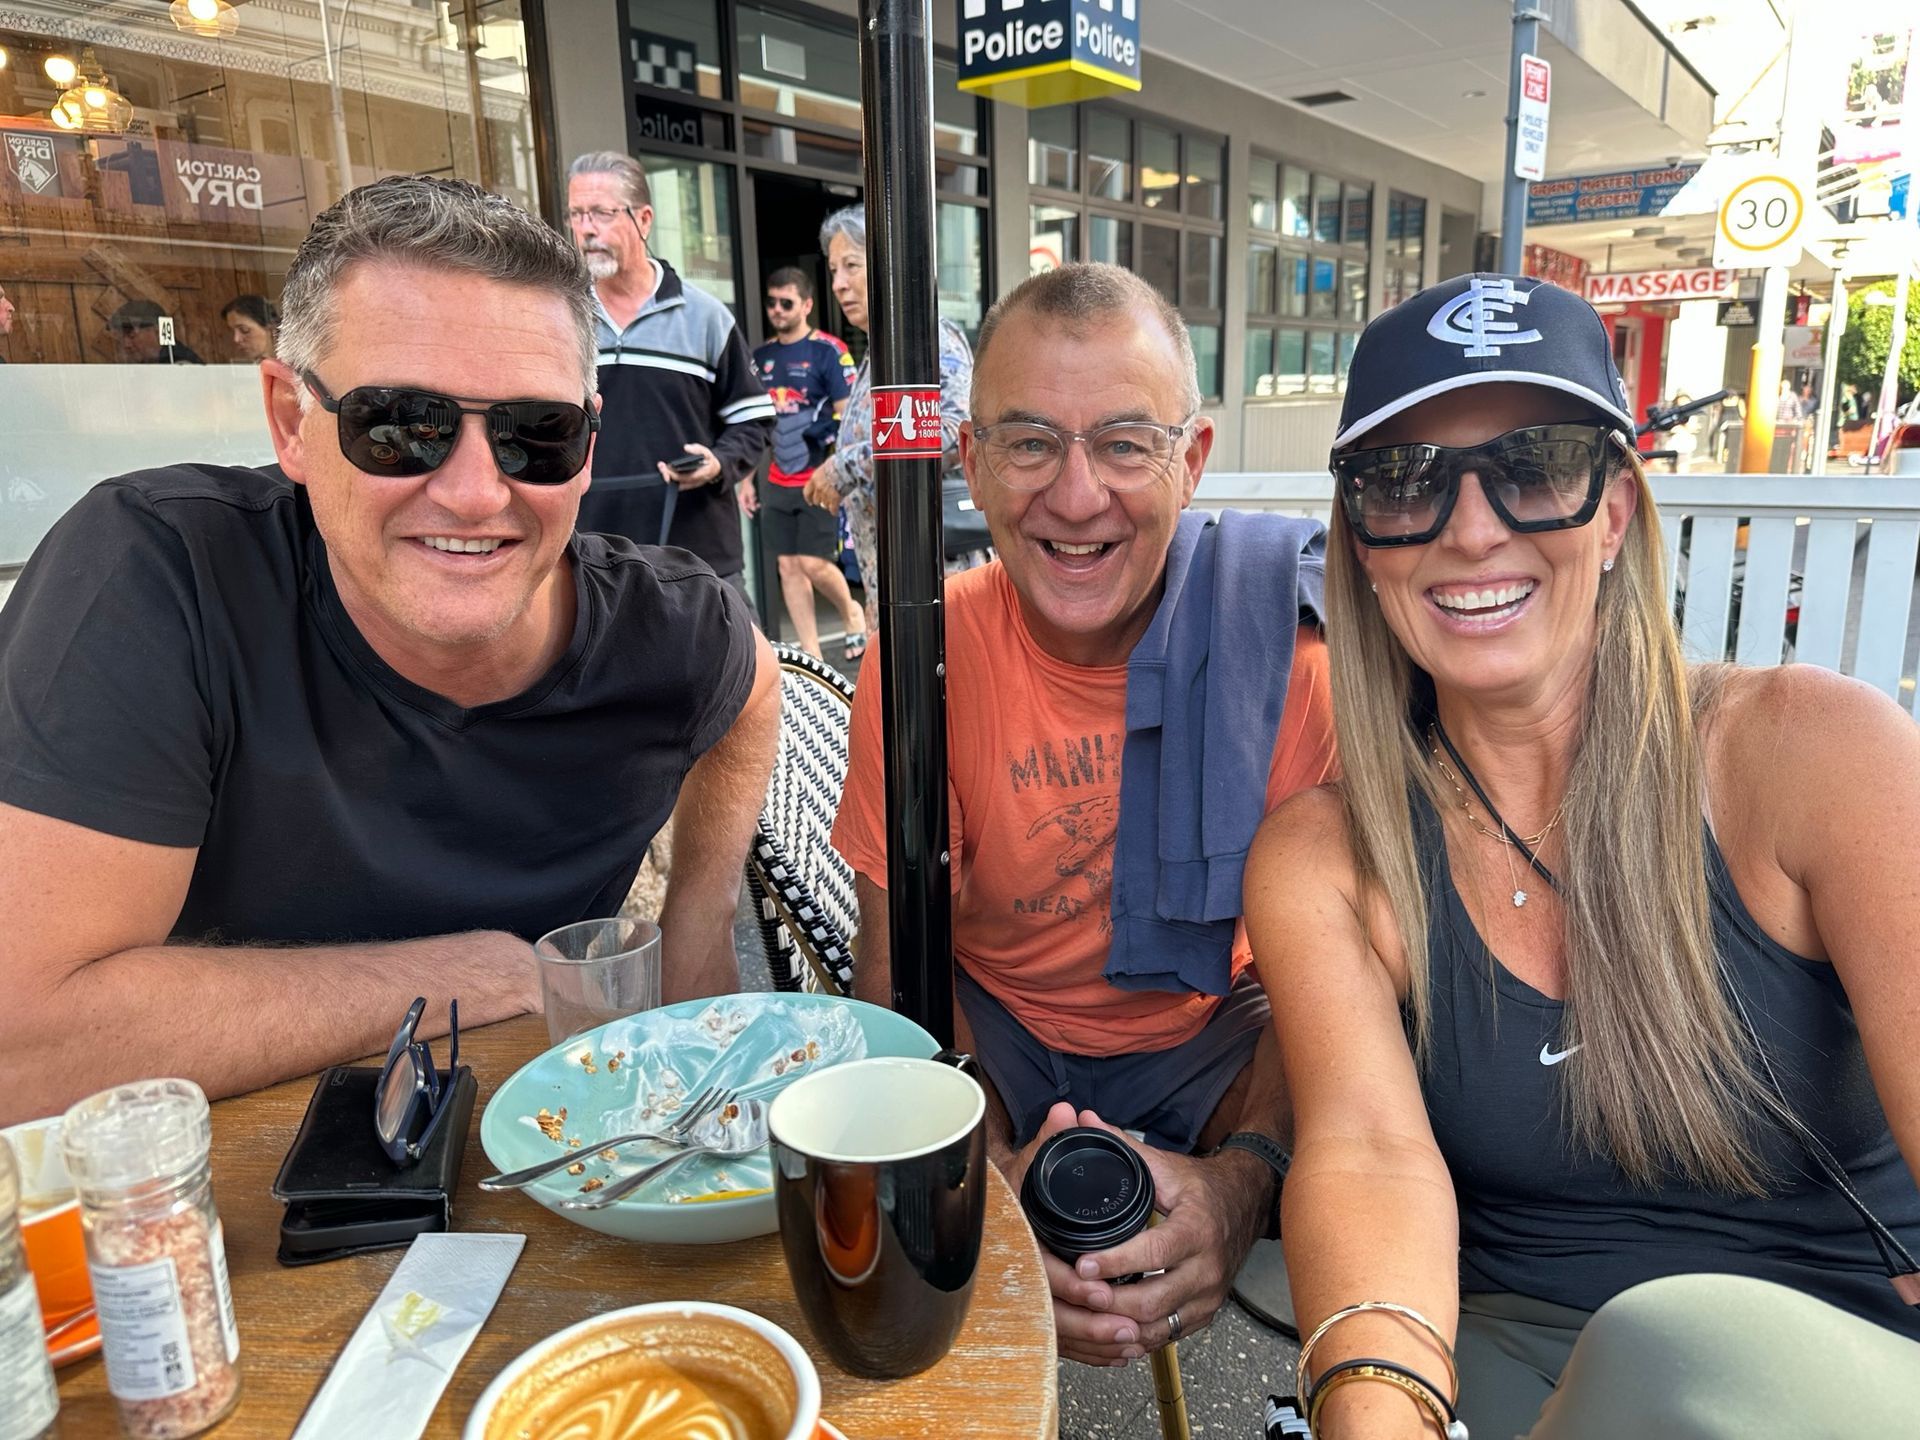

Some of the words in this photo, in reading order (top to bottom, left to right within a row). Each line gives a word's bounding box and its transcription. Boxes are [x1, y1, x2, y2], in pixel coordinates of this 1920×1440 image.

[964, 19, 1064, 66] Police
[1076, 12, 1136, 66] Police
[1529, 181, 1576, 197] GRAND
[1580, 174, 1633, 192] MASTER
[1737, 198, 1787, 230] 30
[1590, 270, 1727, 298] MASSAGE
[161, 321, 171, 340] 49
[1101, 1177, 1129, 1215] CAUTION
[1074, 1207, 1099, 1217] HOT
